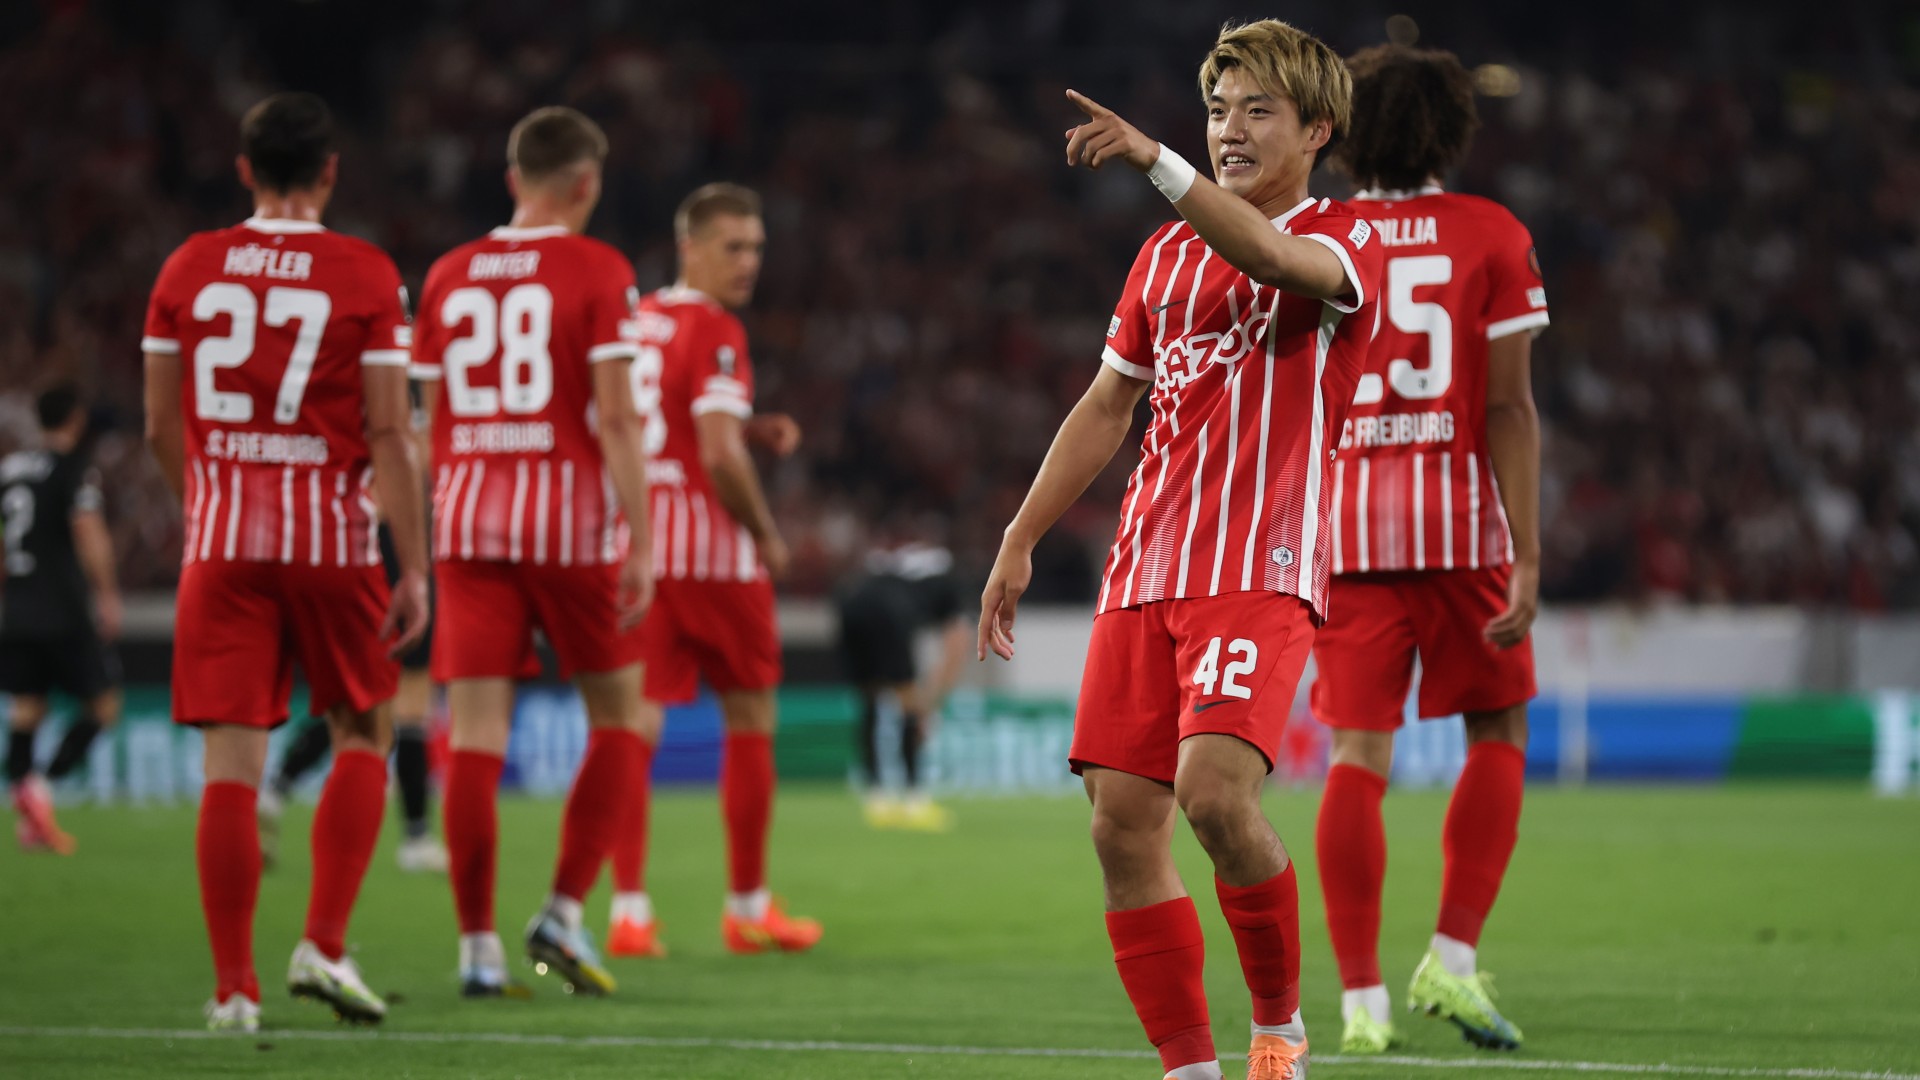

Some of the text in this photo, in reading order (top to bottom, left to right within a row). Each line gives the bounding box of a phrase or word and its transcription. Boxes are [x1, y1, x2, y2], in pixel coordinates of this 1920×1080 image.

[223, 243, 313, 280] HÖFLER
[193, 281, 332, 425] 27
[441, 283, 553, 417] 28
[1354, 410, 1455, 448] FREIBURG
[1193, 636, 1258, 700] 42
